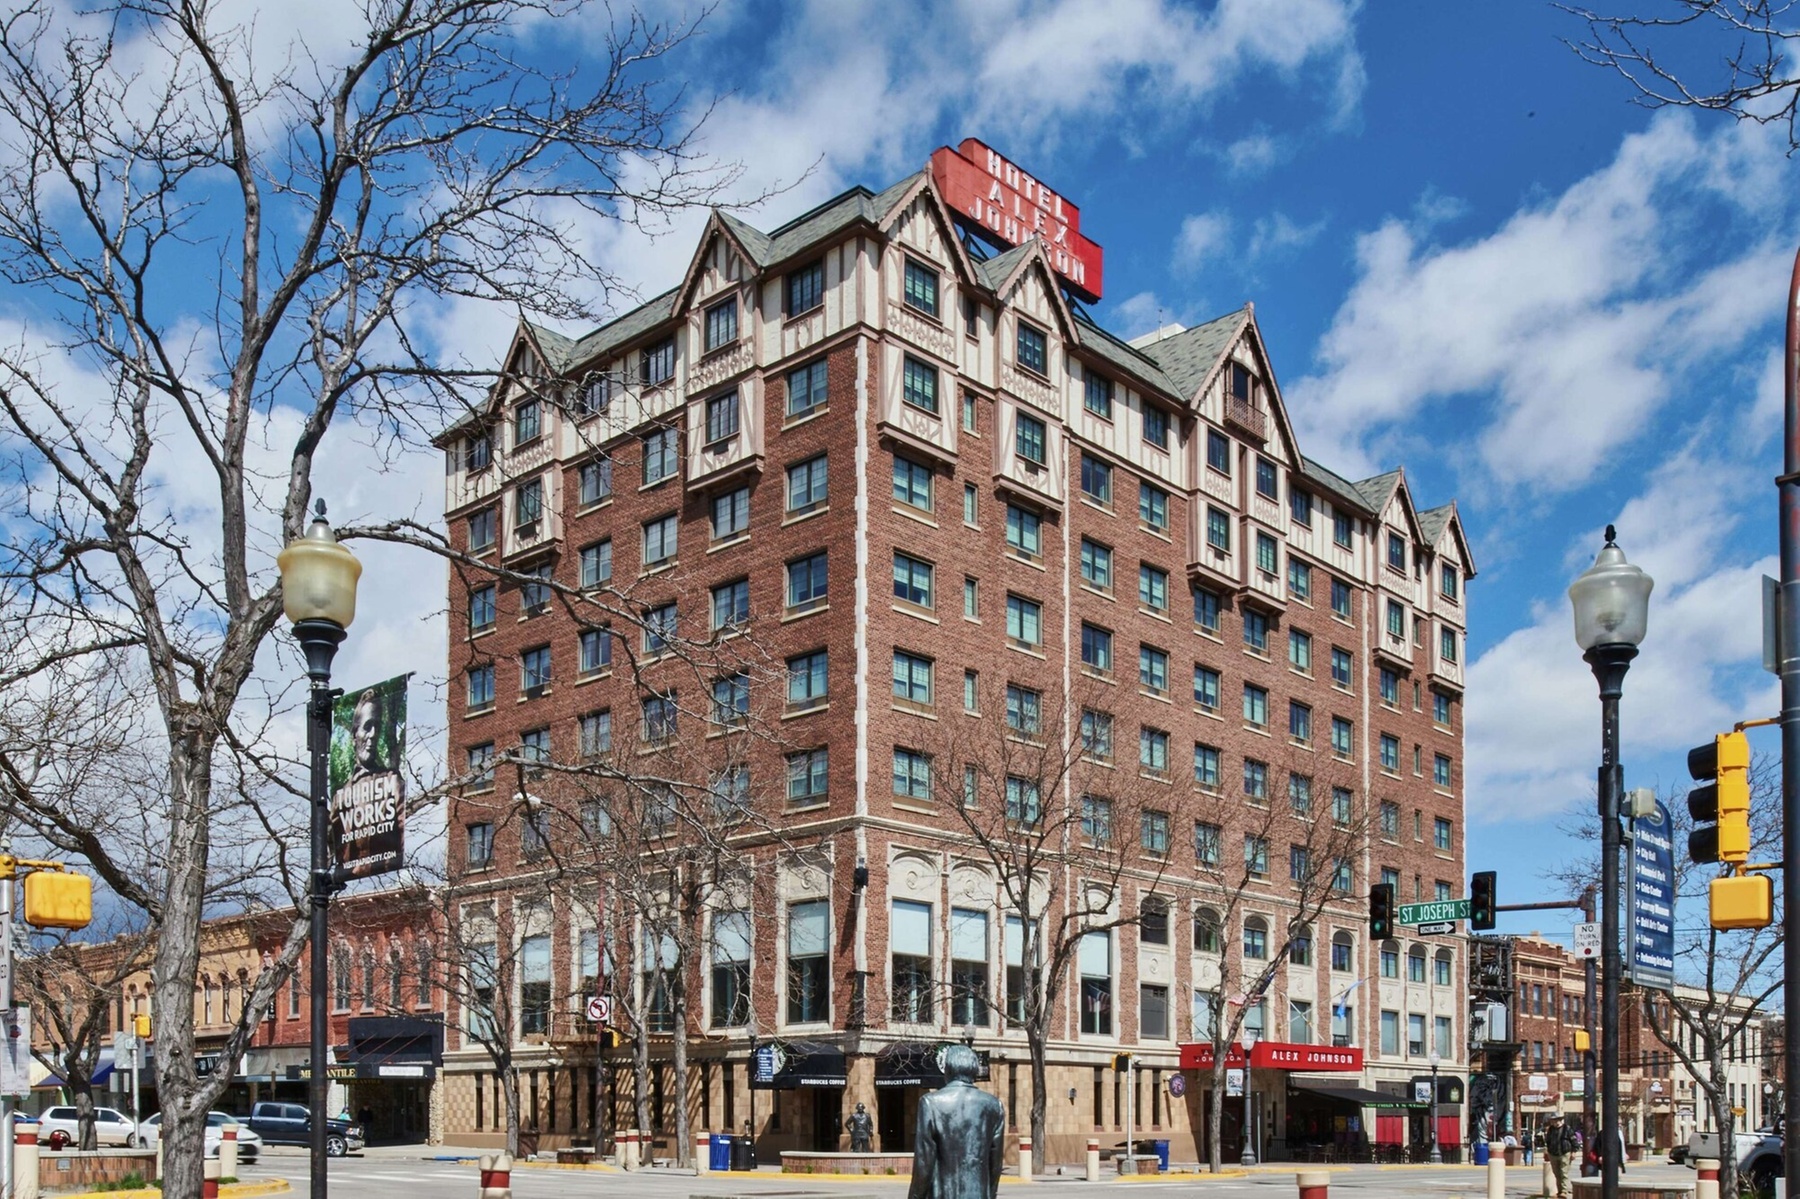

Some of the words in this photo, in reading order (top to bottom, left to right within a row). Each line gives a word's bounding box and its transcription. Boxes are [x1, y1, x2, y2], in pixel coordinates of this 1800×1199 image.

[987, 148, 1068, 224] HOTEL
[988, 180, 1068, 249] ALEX
[337, 775, 397, 809] TOURISM
[340, 798, 395, 832] WORKS
[341, 831, 354, 844] FOR
[354, 825, 376, 840] RAPID
[377, 821, 395, 834] CITY
[343, 851, 397, 869] VISITRAPIDCITY.COM
[1402, 907, 1413, 922] ST
[1417, 903, 1456, 921] JOSEPH
[1421, 926, 1431, 934] ONE
[1581, 925, 1594, 933] NO
[1587, 939, 1601, 947] RED
[1271, 1050, 1299, 1061] ALEX
[1307, 1052, 1353, 1064] JOHNSON
[829, 1078, 846, 1086] COFFEE
